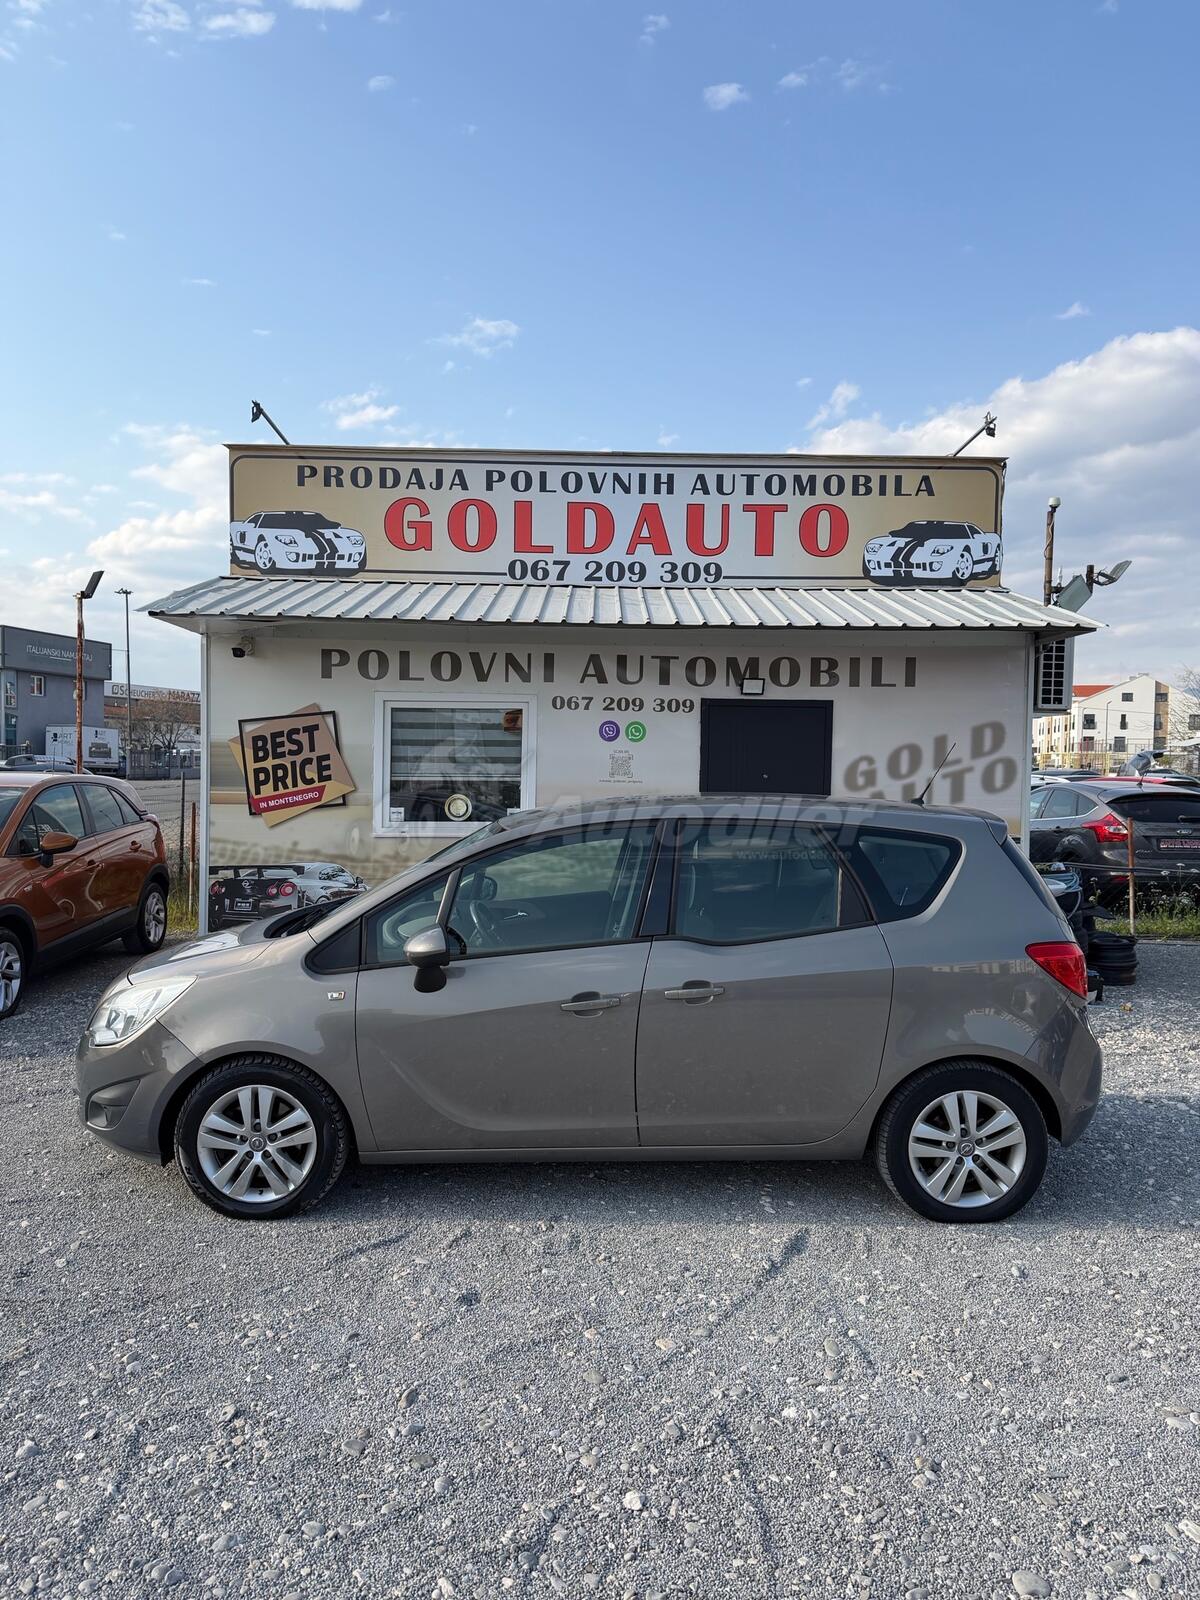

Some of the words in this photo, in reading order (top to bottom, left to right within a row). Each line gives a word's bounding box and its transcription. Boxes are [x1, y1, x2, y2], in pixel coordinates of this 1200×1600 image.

[296, 464, 470, 491] PRODAJA
[485, 469, 676, 495] POLOVNIH
[690, 472, 936, 497] AUTOMOBILA
[384, 496, 850, 557] GOLDAUTO
[507, 558, 570, 582] 067
[584, 560, 647, 583] 209
[659, 561, 724, 584] 309
[320, 648, 555, 683] POLOVNI
[579, 653, 917, 688] AUTOMOBILI
[551, 695, 594, 711] 067
[602, 696, 645, 712] 209
[652, 697, 695, 713] 309
[251, 723, 320, 763] BEST
[843, 720, 1007, 792] GOLD
[252, 753, 332, 795] PRICE
[268, 791, 320, 807] MONTENEGRO
